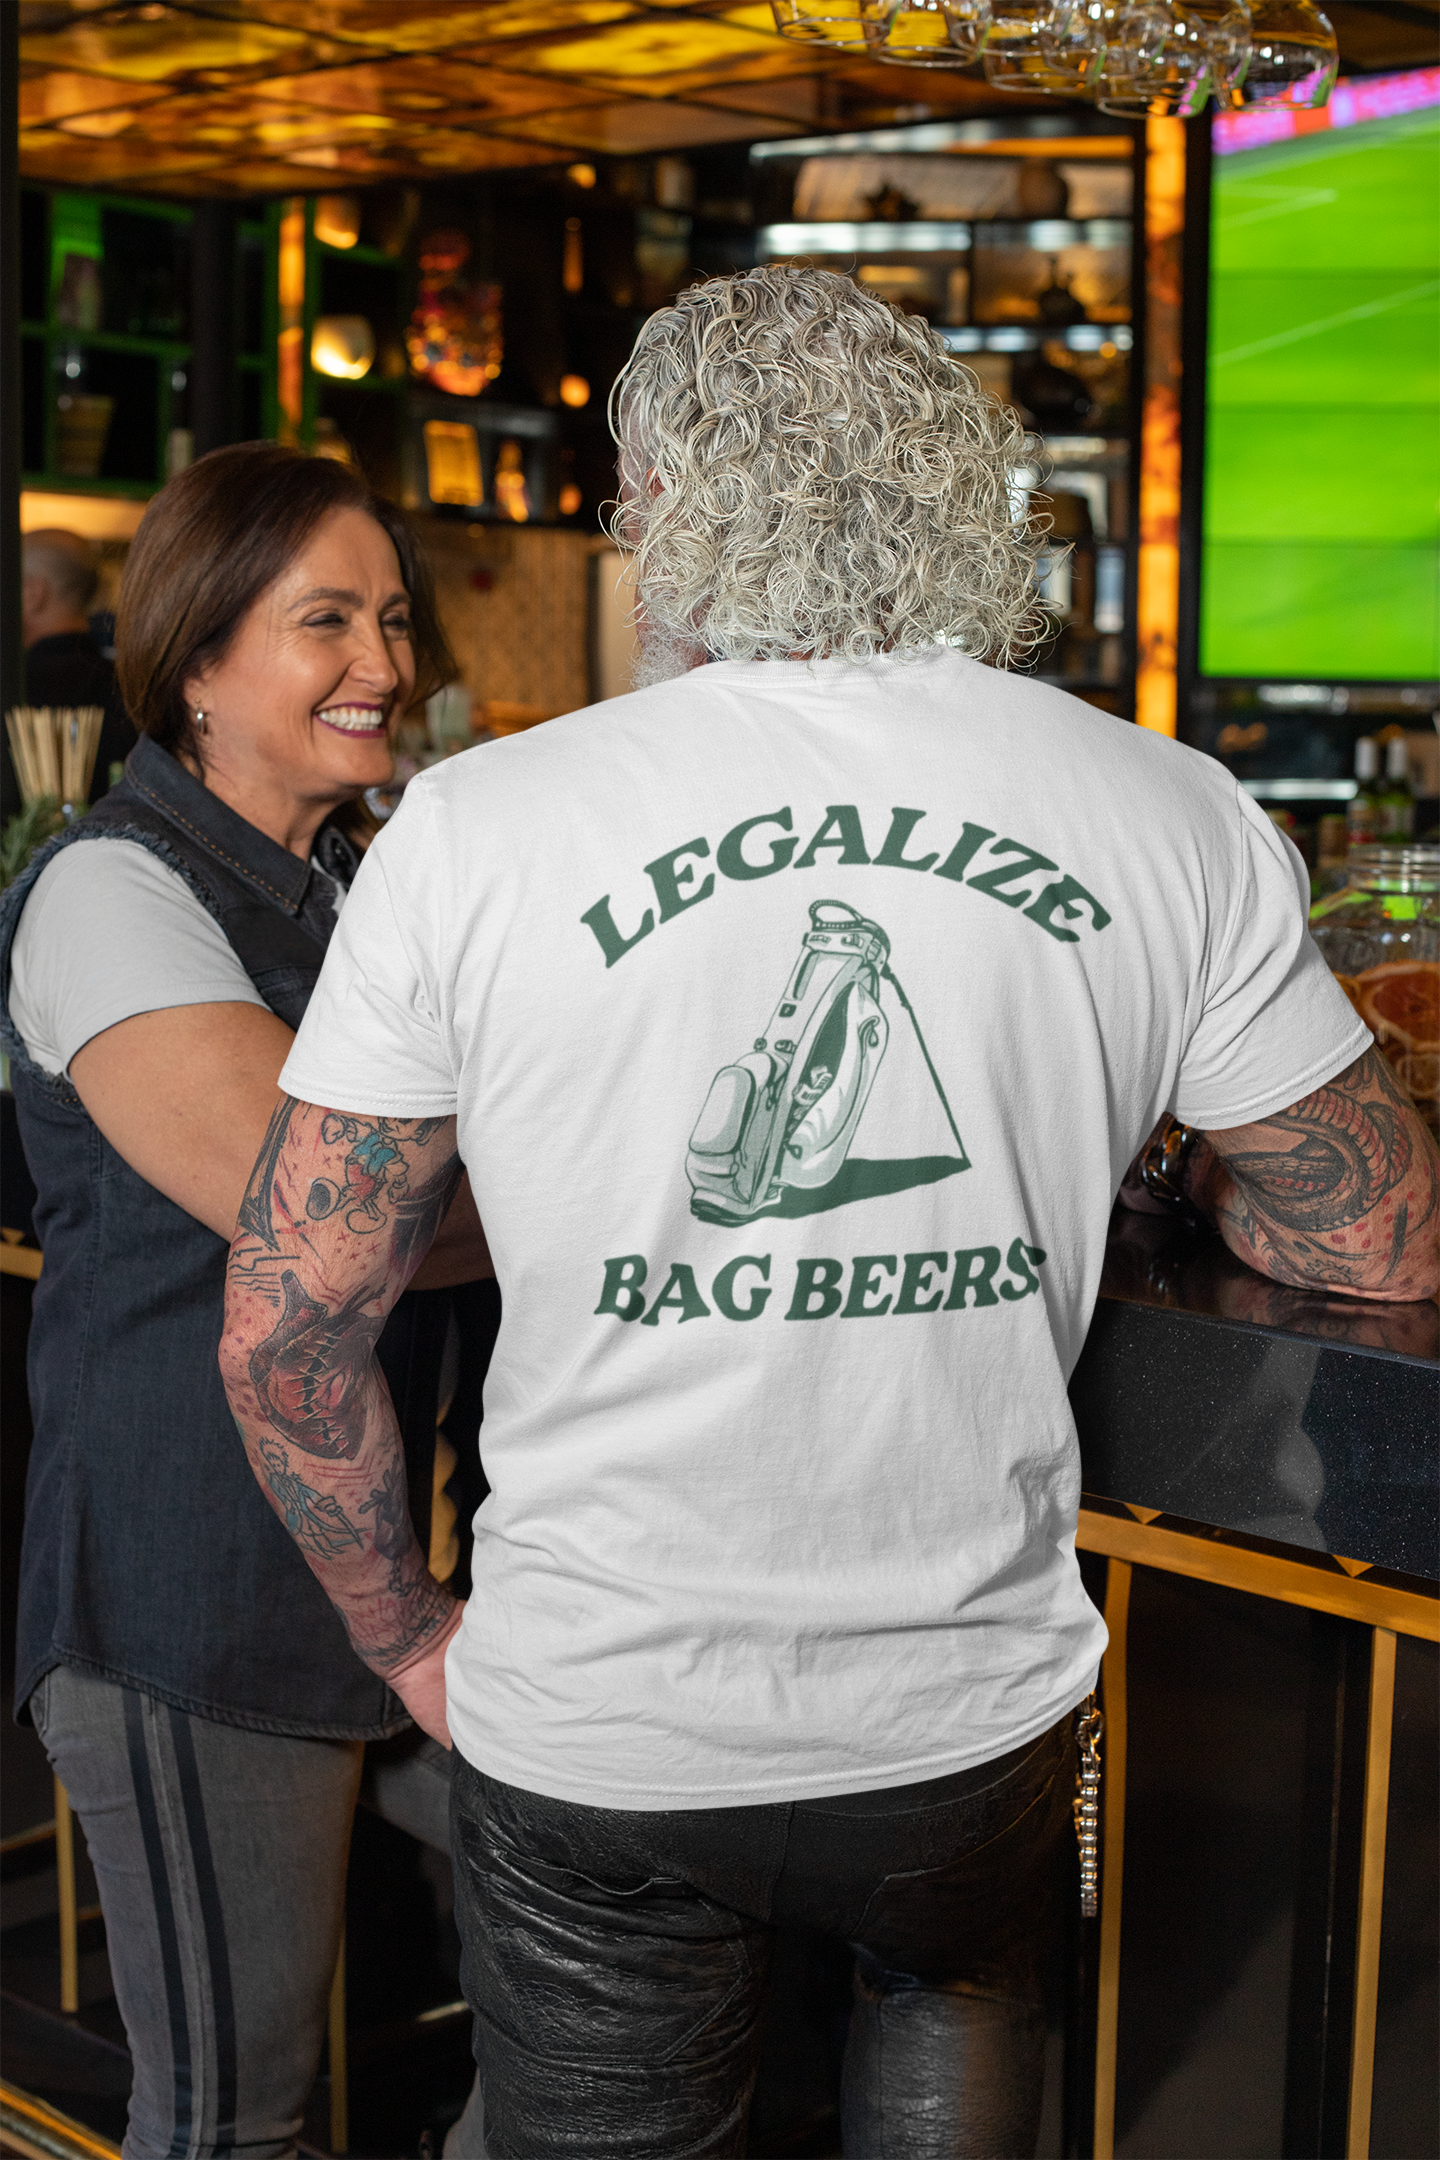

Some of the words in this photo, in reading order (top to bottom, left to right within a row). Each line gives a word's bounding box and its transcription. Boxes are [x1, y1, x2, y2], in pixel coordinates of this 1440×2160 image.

[580, 805, 1111, 969] LEGALIZE
[594, 1253, 772, 1326] BAG
[784, 1237, 1047, 1321] BEERS
